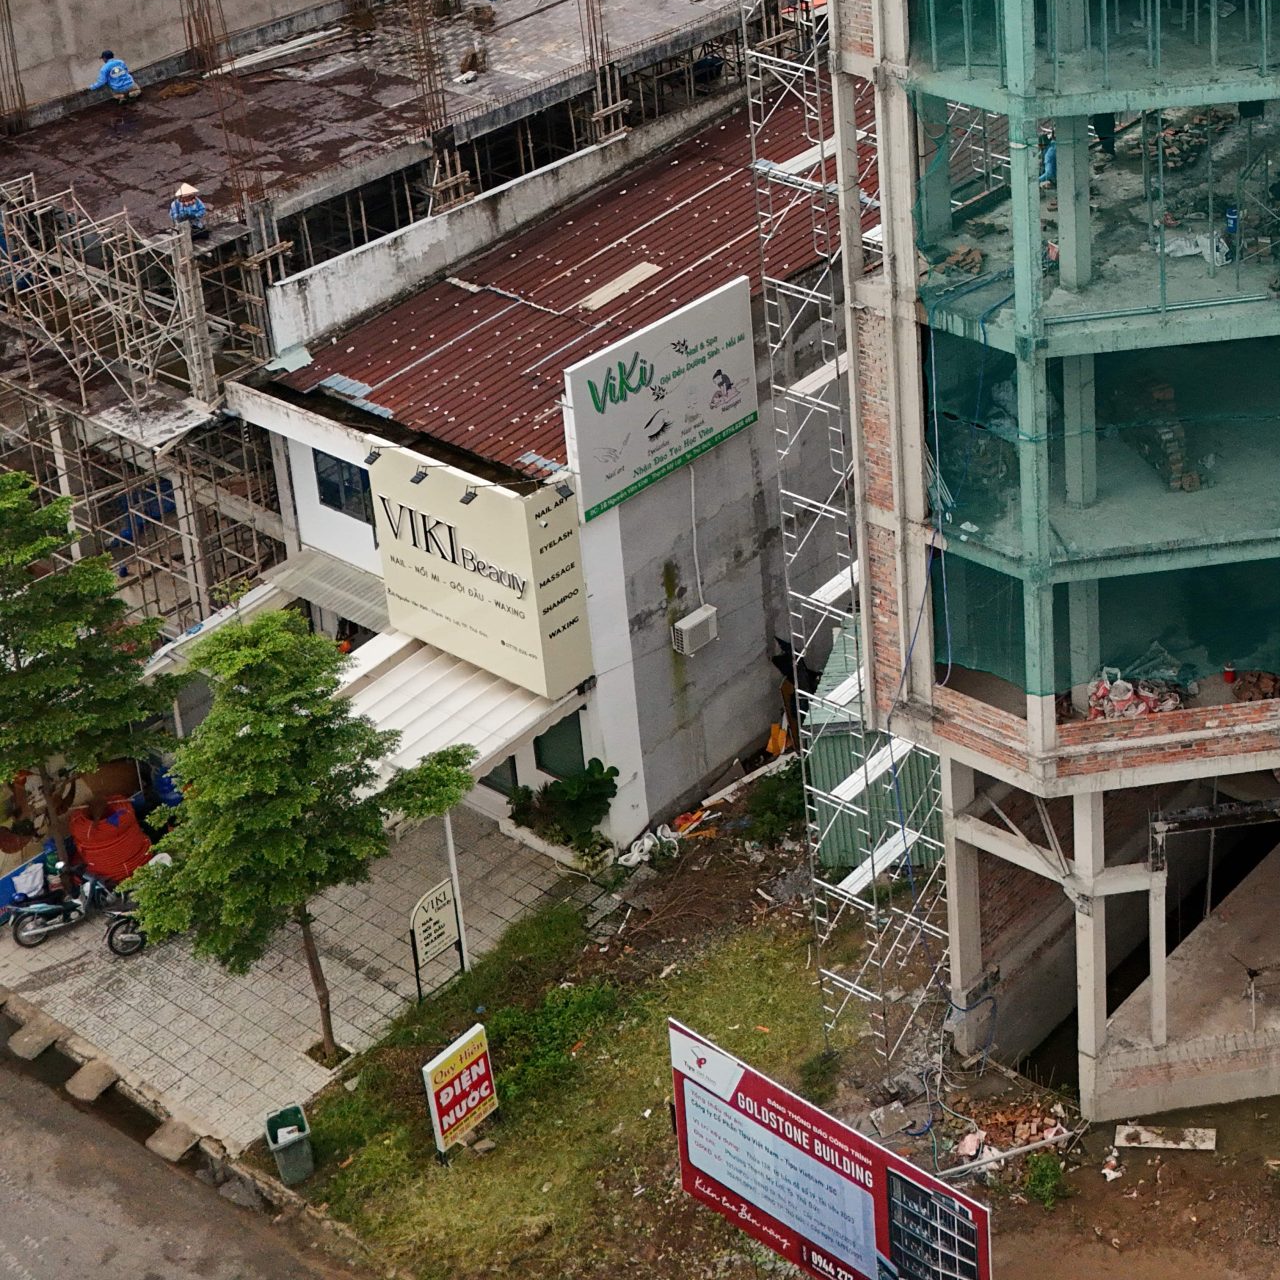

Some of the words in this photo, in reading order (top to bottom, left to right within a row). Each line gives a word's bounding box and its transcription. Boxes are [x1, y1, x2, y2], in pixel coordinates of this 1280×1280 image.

[534, 507, 552, 520] NAIL
[554, 497, 569, 509] ART
[378, 494, 460, 566] VIKI
[461, 547, 526, 600] Beauty
[539, 529, 573, 555] EYELASH
[390, 555, 406, 567] NAIL
[431, 573, 440, 583] MI
[494, 599, 525, 619] WAXING
[539, 561, 575, 589] MASSAGE
[542, 588, 579, 615] SHAMPOO
[549, 616, 579, 639] WAXING
[421, 891, 447, 913] VIKI
[439, 1058, 486, 1107] ĐIỆN
[442, 1080, 491, 1131] NƯỚC
[737, 1092, 810, 1149] GOLDSTONE
[814, 1139, 873, 1188] BUILDING
[787, 1110, 812, 1129] THÔNG
[813, 1125, 828, 1139] BÁO
[829, 1135, 849, 1152] CÔNG
[764, 1145, 779, 1159] Nam
[812, 1251, 835, 1275] 0944
